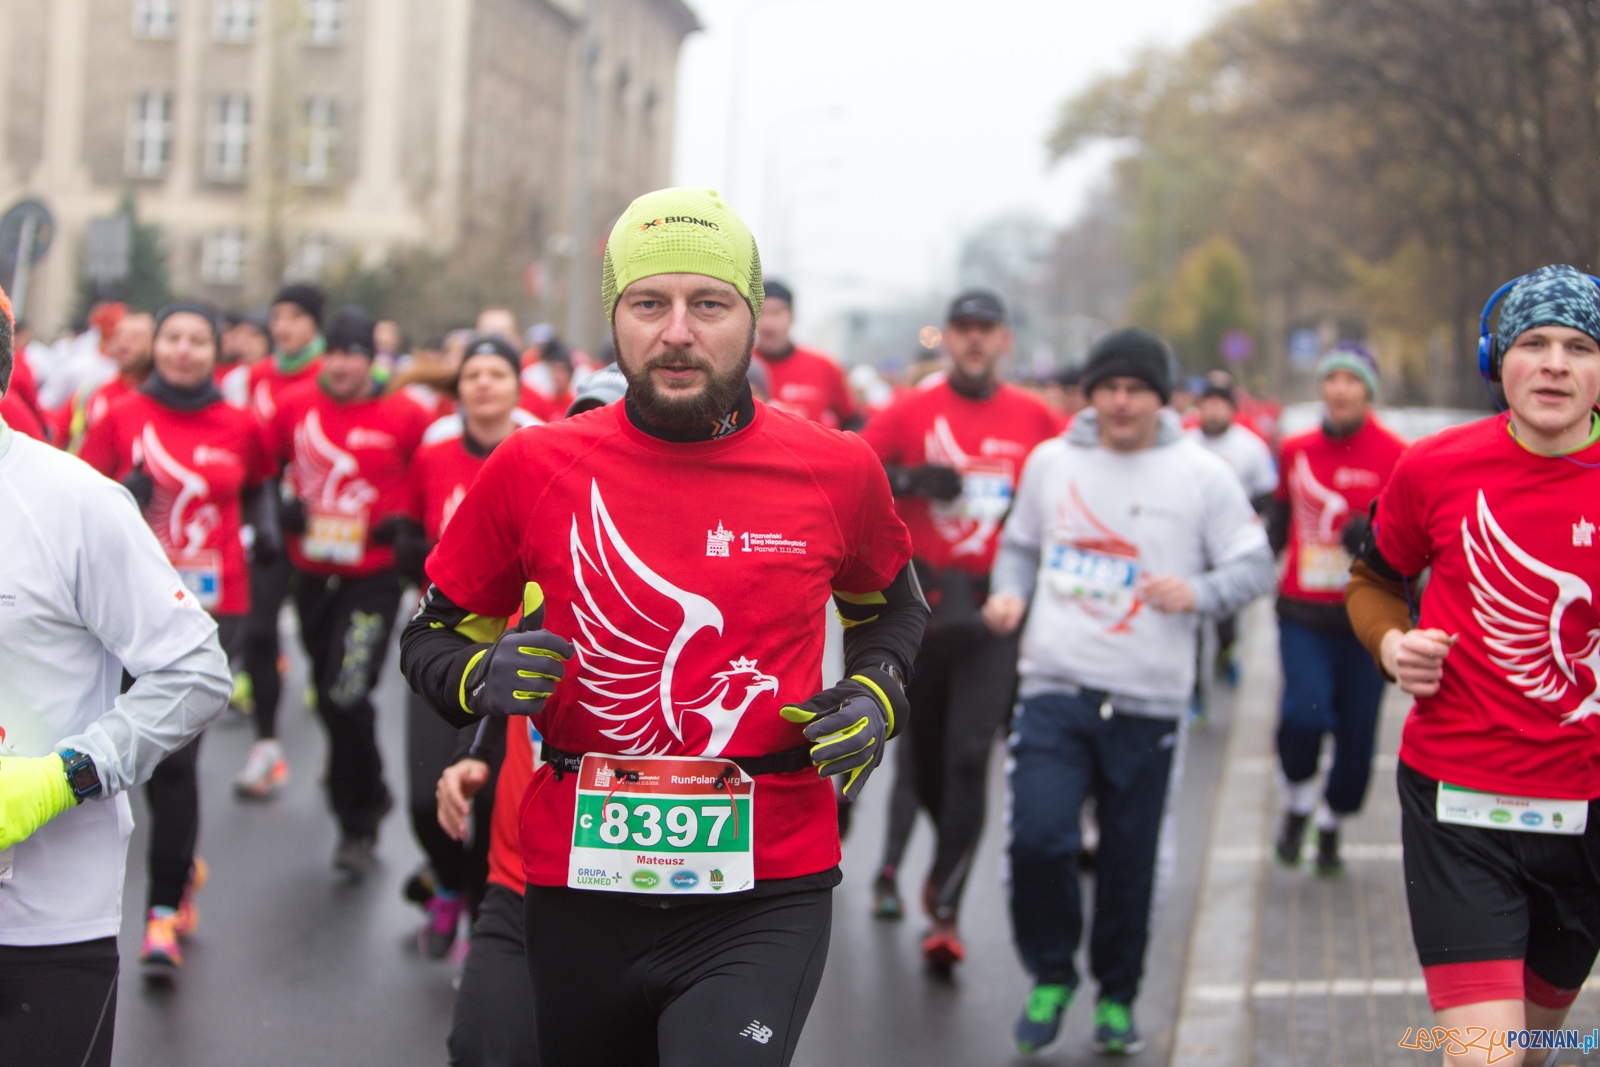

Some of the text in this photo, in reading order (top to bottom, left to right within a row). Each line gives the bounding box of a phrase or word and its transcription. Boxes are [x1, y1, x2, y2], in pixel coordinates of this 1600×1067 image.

[664, 216, 719, 231] BIONIC
[740, 532, 752, 552] 1
[564, 757, 581, 766] perf
[579, 802, 732, 848] C 8397
[636, 855, 685, 866] Mateusz
[578, 868, 607, 878] GRUPA
[577, 876, 611, 886] LUXMED
